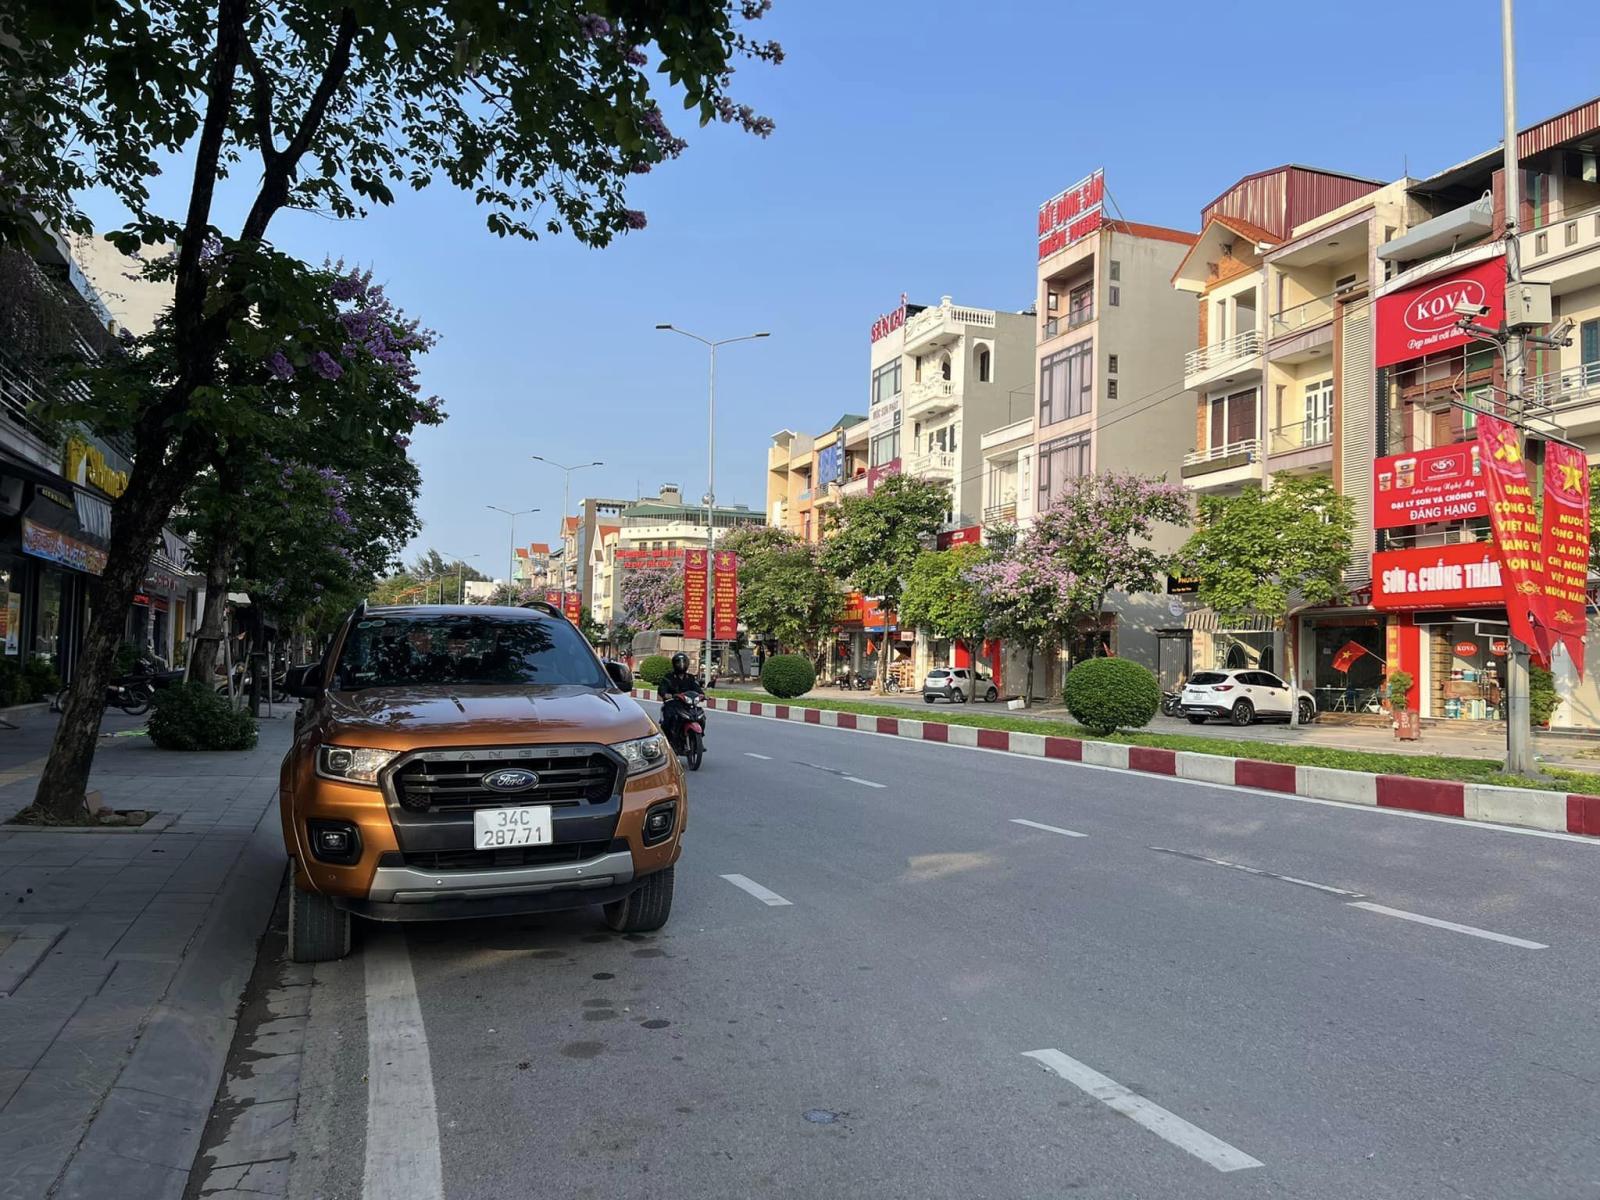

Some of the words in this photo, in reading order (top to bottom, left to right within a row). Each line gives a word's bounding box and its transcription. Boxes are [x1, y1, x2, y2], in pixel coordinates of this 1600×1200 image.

[1417, 289, 1470, 320] KOVA
[1407, 572, 1418, 592] &
[497, 773, 525, 787] Ford
[498, 810, 530, 826] 34C
[484, 827, 542, 846] 287.71
